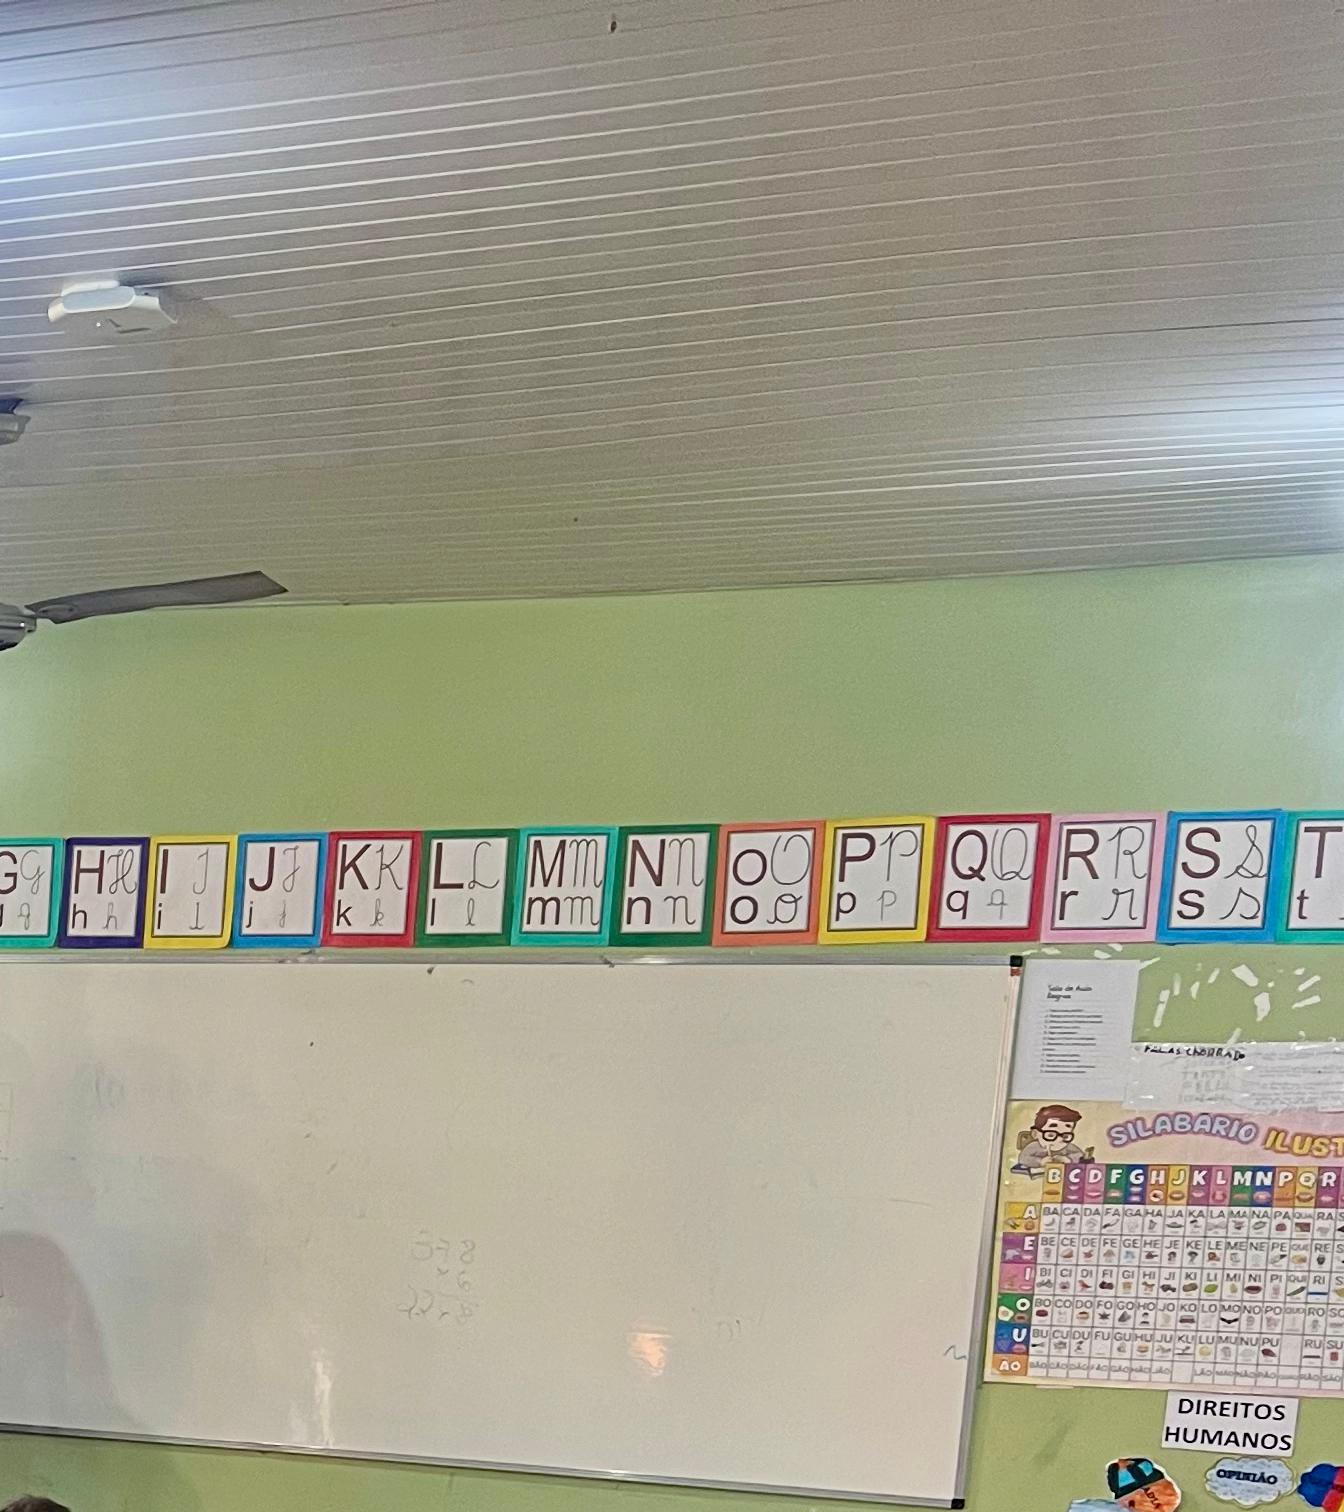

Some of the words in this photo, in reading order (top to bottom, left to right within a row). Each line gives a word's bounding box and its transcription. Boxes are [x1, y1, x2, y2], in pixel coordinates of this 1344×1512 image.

[339, 844, 371, 889] K
[434, 843, 463, 889] L
[530, 840, 566, 887] M
[629, 839, 665, 887] N
[839, 833, 875, 882] P
[952, 830, 987, 881] Q
[1063, 829, 1099, 880] R
[1182, 828, 1220, 878] S
[1304, 827, 1343, 878] T
[75, 850, 104, 894] H
[249, 847, 275, 891] J
[72, 904, 87, 928] h
[337, 900, 352, 926] k
[527, 897, 560, 925] m
[627, 897, 651, 924] n
[731, 896, 758, 924] o
[836, 893, 856, 921] p
[947, 891, 968, 919] q
[1059, 891, 1078, 920] r
[1177, 890, 1204, 919] s
[1297, 890, 1308, 919] t
[1048, 1169, 1060, 1183] B
[1069, 1169, 1081, 1183] C
[1088, 1169, 1102, 1183] D
[1111, 1169, 1122, 1183] F
[1130, 1169, 1144, 1184] G
[1151, 1169, 1165, 1185] H
[1173, 1169, 1185, 1185] J
[1193, 1170, 1207, 1185] K
[1216, 1170, 1226, 1185] L
[1233, 1171, 1252, 1186] M
[1255, 1171, 1273, 1186] N
[1279, 1171, 1293, 1187] P
[1299, 1171, 1316, 1189] Q
[1322, 1172, 1336, 1187] R
[1024, 1205, 1037, 1219] A
[1023, 1236, 1035, 1250] E
[1013, 1328, 1026, 1342] U
[1178, 1398, 1286, 1421] DIREITOS
[1165, 1426, 1292, 1451] HUMANOS
